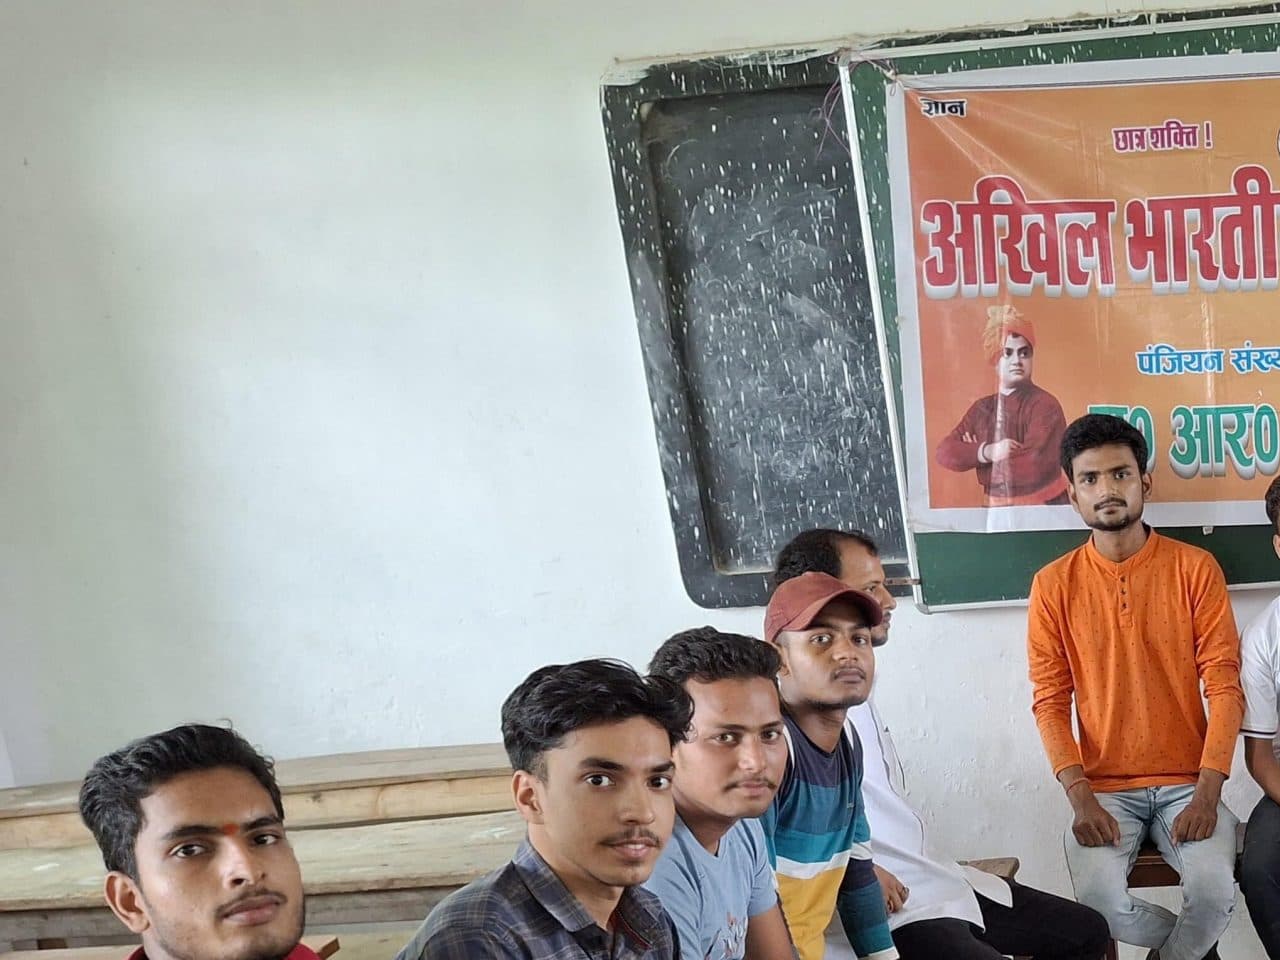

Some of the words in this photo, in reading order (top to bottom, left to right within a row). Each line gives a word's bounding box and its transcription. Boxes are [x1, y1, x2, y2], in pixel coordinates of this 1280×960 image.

[1112, 127, 1147, 152] छात्र
[1149, 120, 1199, 150] शक्ति
[921, 175, 1117, 297] अखिल
[1136, 343, 1225, 374] पंजियन
